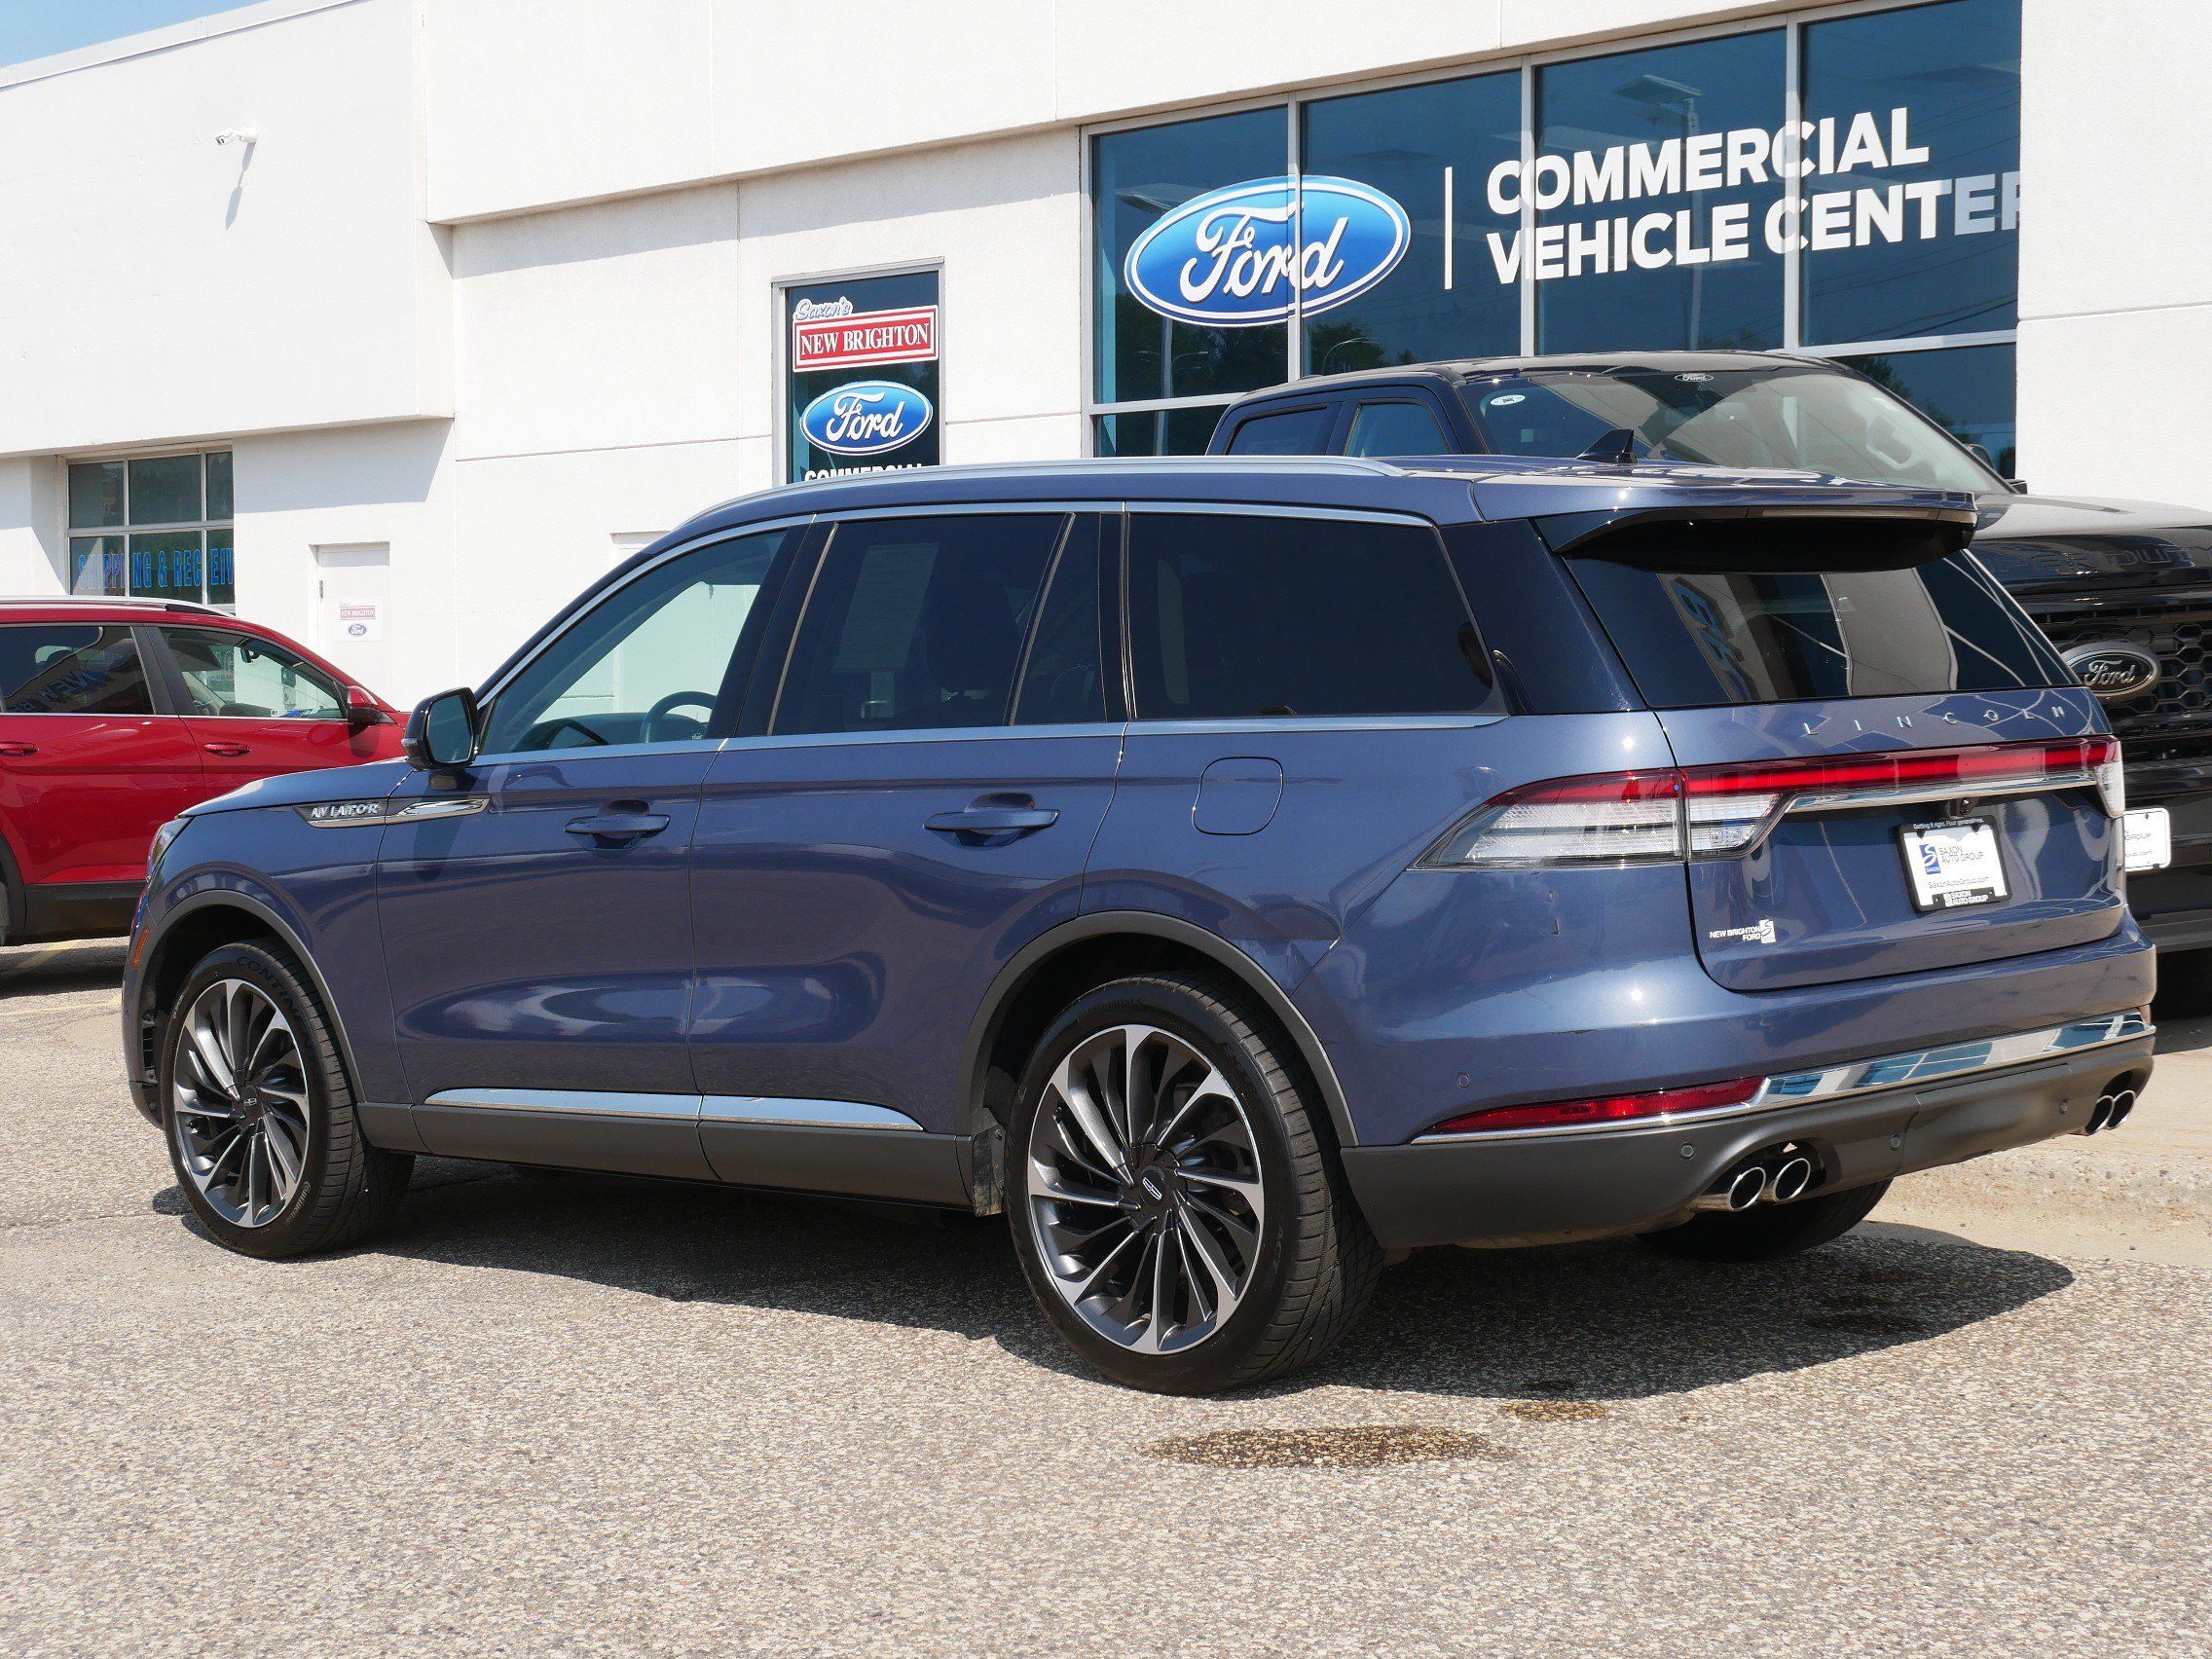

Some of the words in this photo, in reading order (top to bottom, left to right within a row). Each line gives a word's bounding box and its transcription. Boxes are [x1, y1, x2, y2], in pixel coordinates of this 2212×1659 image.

[1487, 107, 1930, 215] COMMERCIAL
[1180, 201, 1349, 303] Ford
[1487, 203, 1750, 284] VEHICLE
[795, 297, 852, 320] Saxon's
[800, 332, 839, 355] NEW
[843, 322, 930, 351] BRIGHTON
[826, 391, 903, 442] Ford
[79, 551, 151, 589] SHIPPING
[158, 551, 167, 588] &
[2083, 659, 2138, 685] Ford
[1803, 705, 2066, 736] LINCOLN
[311, 802, 379, 819] AVIATOR
[1938, 846, 1963, 856] SAXON
[1941, 854, 1960, 864] AUTO
[1961, 851, 1984, 862] GROUP
[1726, 926, 1760, 937] BRIGHTON
[1742, 933, 1761, 941] FORD
